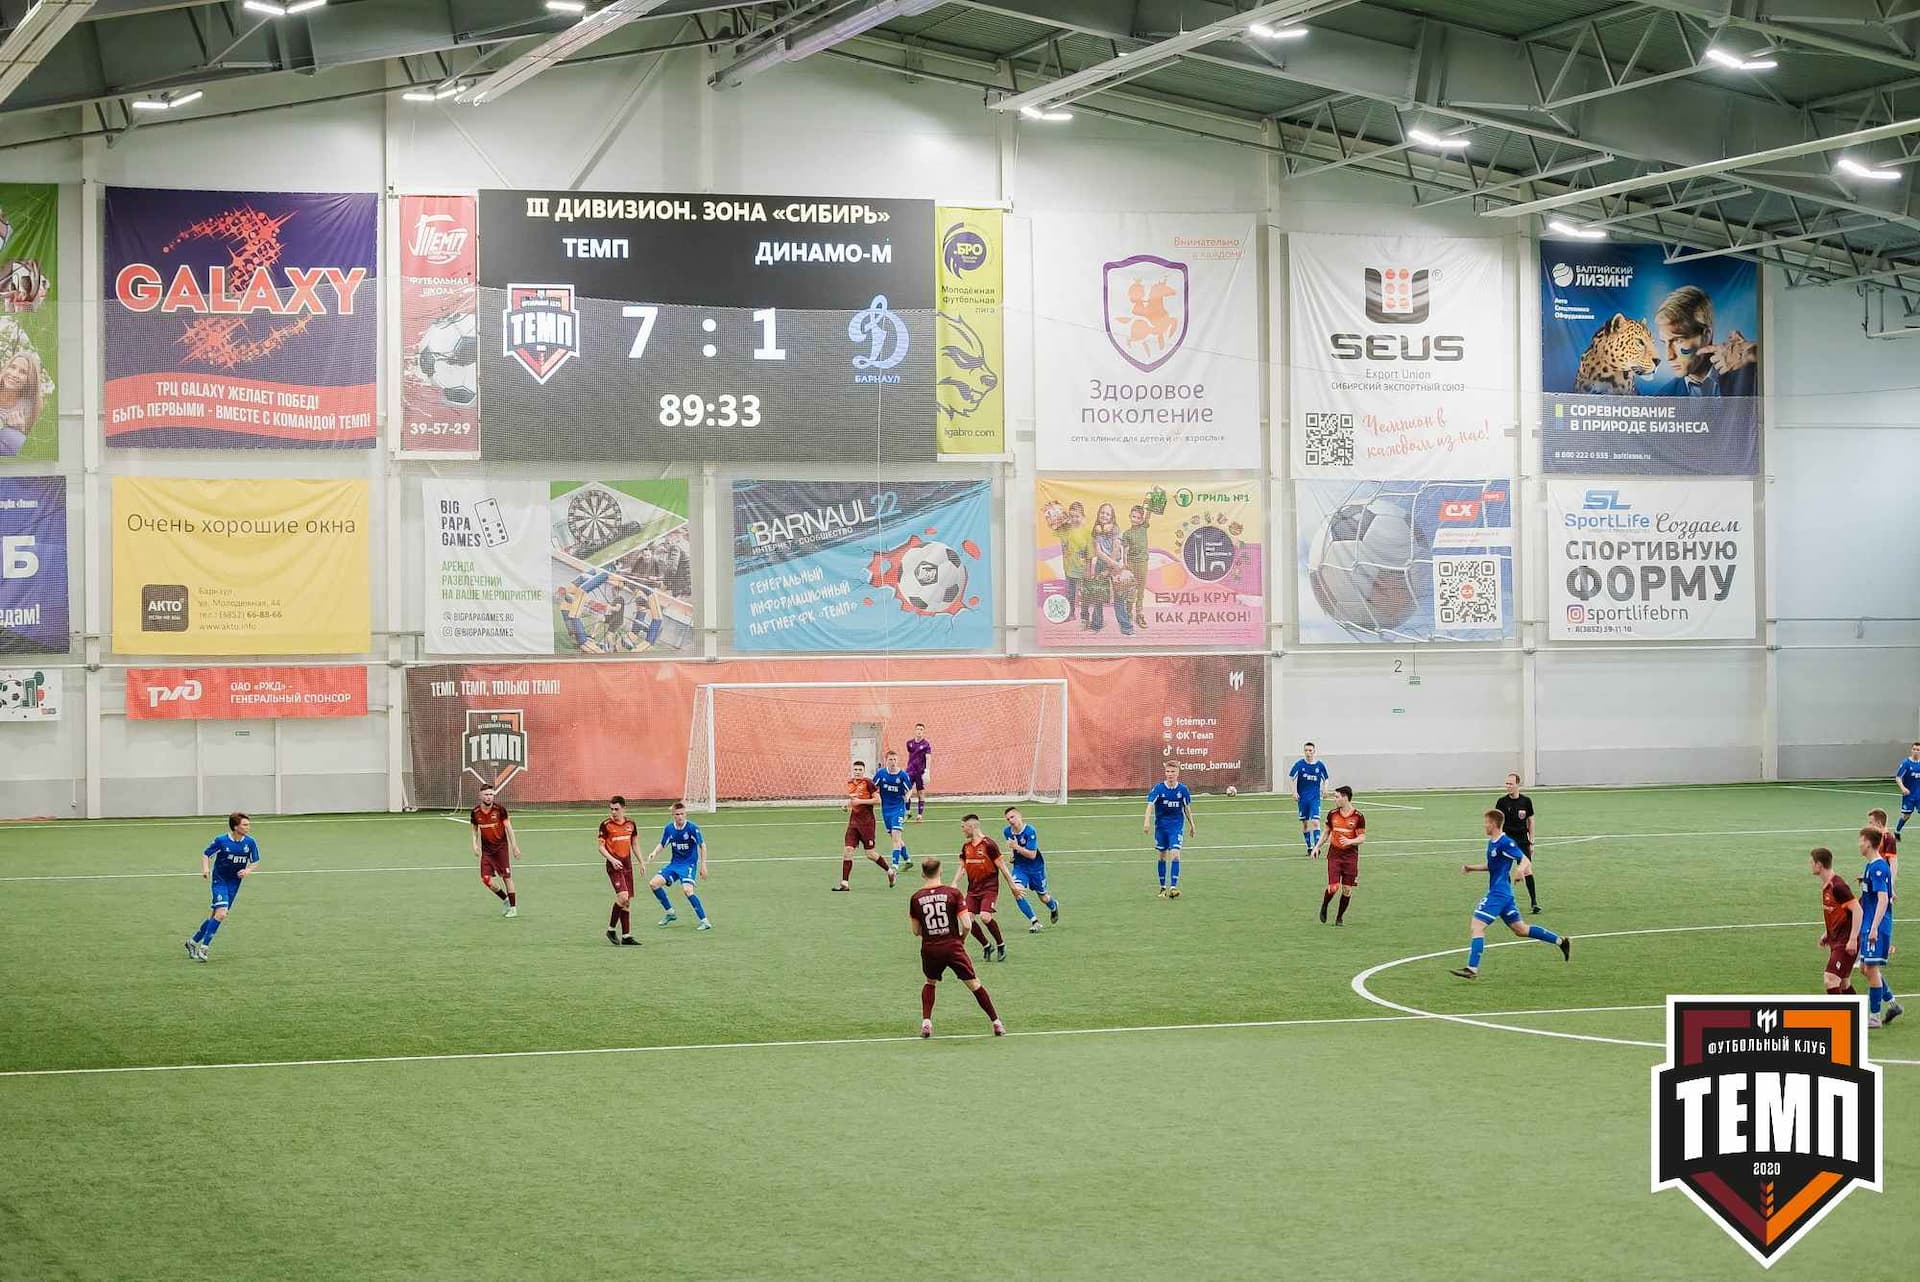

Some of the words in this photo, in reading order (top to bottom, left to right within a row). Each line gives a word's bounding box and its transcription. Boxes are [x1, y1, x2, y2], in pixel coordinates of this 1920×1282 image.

[554, 198, 698, 222] ДИВИЗИОН.
[702, 201, 767, 221] ЗОНА
[772, 203, 891, 224] «СИБИРЬ»
[562, 237, 629, 259] ТЕМП
[755, 240, 892, 265] ДИНАМО-М
[1575, 265, 1633, 274] БАЛТИЙСКИЙ
[1575, 274, 1633, 287] ЛИЗИНГ
[115, 264, 367, 315] GALAXY
[510, 311, 573, 347] ТЕМП
[622, 306, 659, 358] 7
[752, 307, 786, 360] 1
[1331, 334, 1465, 361] SEUS
[855, 375, 900, 384] БАРНАУЛ
[1366, 368, 1398, 380] Export
[1401, 368, 1431, 380] Union
[1090, 377, 1205, 402] Здоровое
[1331, 382, 1382, 391] СИБИРСКИЙ
[1383, 382, 1440, 392] ЭКСПОРТНЫЙ
[1442, 383, 1465, 392] СОЮЗ
[156, 382, 179, 397] ТРЦ
[181, 382, 225, 399] GALAXY
[228, 387, 273, 405] ЖЕЛАЕТ
[277, 393, 319, 410] ПОБЕД!
[112, 406, 144, 423] БЫТЬ
[147, 403, 205, 417] ПЕРВЫМИ
[215, 405, 260, 424] ВМЕСТЕ
[263, 411, 270, 425] С
[273, 411, 336, 430] КОМАНДОЙ
[338, 412, 371, 429] ТЕМП!
[659, 394, 761, 427] 89:33
[1081, 407, 1213, 424] поколение
[1570, 405, 1676, 418] СОРЕВНОВАНИЕ
[410, 422, 471, 436] 39-57-29
[1570, 420, 1579, 431] В
[1582, 420, 1647, 434] ПРИРОДЕ
[1650, 422, 1709, 433] БИЗНЕСА
[1198, 494, 1230, 502] ГРИЛЬ
[441, 500, 460, 514] BIG
[126, 513, 195, 535] Очень
[201, 518, 299, 538] хорошие
[305, 516, 356, 534] окна
[441, 517, 471, 530] PAPA
[1564, 513, 1649, 530] SportLife
[1656, 513, 1742, 540] Создаем
[442, 532, 481, 547] GAMES
[752, 540, 792, 555] ИНТЕРНЕТ
[799, 527, 853, 544] СООБЩЕСТВО
[1565, 540, 1737, 560] СПОРТИВНУЮ
[441, 560, 474, 572] АРЕНДА
[749, 565, 824, 595] ГЕНЕРАЛЬНЫЙ
[1566, 564, 1737, 601] ФОРМУ
[441, 589, 453, 600] НА
[455, 589, 480, 600] ВАШЕ
[482, 590, 544, 600] МЕРОПРИЯТИЕ
[750, 579, 851, 616] ИНФОРМАЦИОННЫЙ
[1155, 592, 1200, 606] БУДЬ
[148, 600, 182, 611] АКТО
[749, 614, 796, 637] ПАРТНЕР
[798, 609, 816, 625] ФК
[1155, 612, 1184, 623] КАК
[1187, 611, 1250, 625] ДРАКОН!
[1587, 605, 1689, 624] sportlifebrn
[1394, 659, 1402, 672] 2
[230, 682, 251, 691] ОАО
[430, 681, 458, 697] ТЕМП,
[461, 681, 489, 696] ТЕМП,
[492, 680, 529, 696] ТОЛЬКО
[532, 680, 560, 695] ТЕМП!
[230, 692, 301, 704] ГЕНЕРАЛЬНЫЙ
[304, 693, 351, 703] СПОНСОР
[1176, 717, 1217, 727] fctemp.ru
[1176, 730, 1190, 740] ФК
[1191, 731, 1214, 740] Темп
[469, 734, 521, 762] ТЕМП
[1176, 747, 1208, 757] fc.temp
[922, 902, 949, 929] 25
